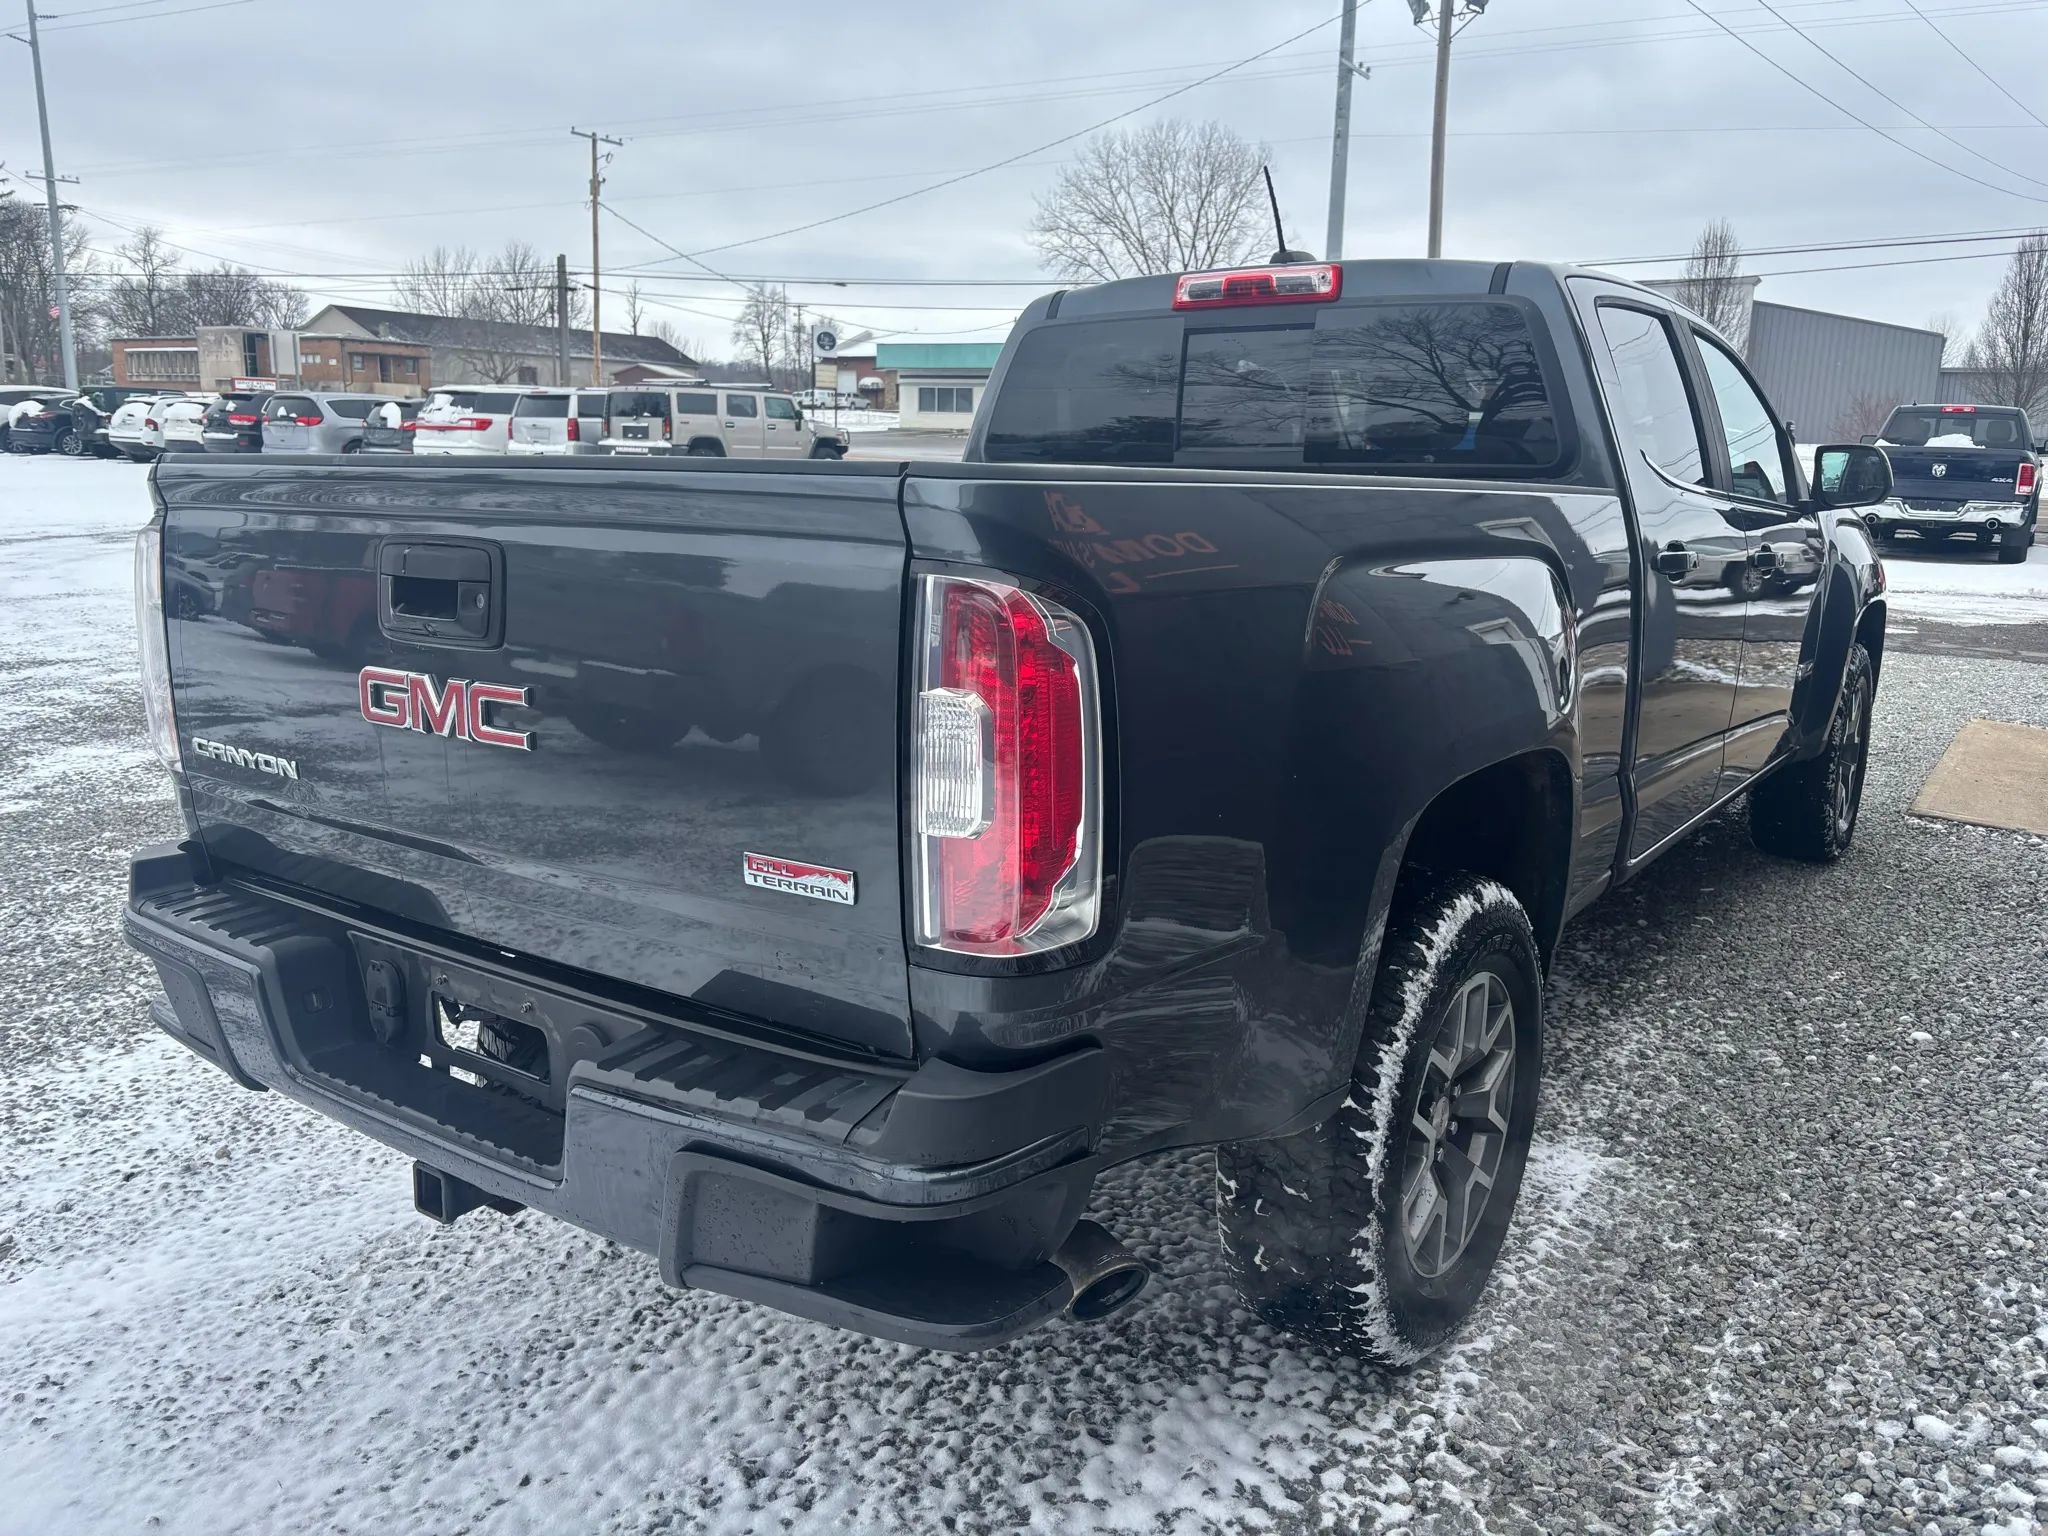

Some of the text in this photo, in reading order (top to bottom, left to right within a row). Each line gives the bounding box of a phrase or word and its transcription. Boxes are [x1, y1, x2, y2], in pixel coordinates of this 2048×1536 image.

[358, 665, 536, 751] GMC
[191, 736, 300, 780] CANYON
[752, 859, 794, 877] ALL
[748, 872, 849, 901] TERRAIN
